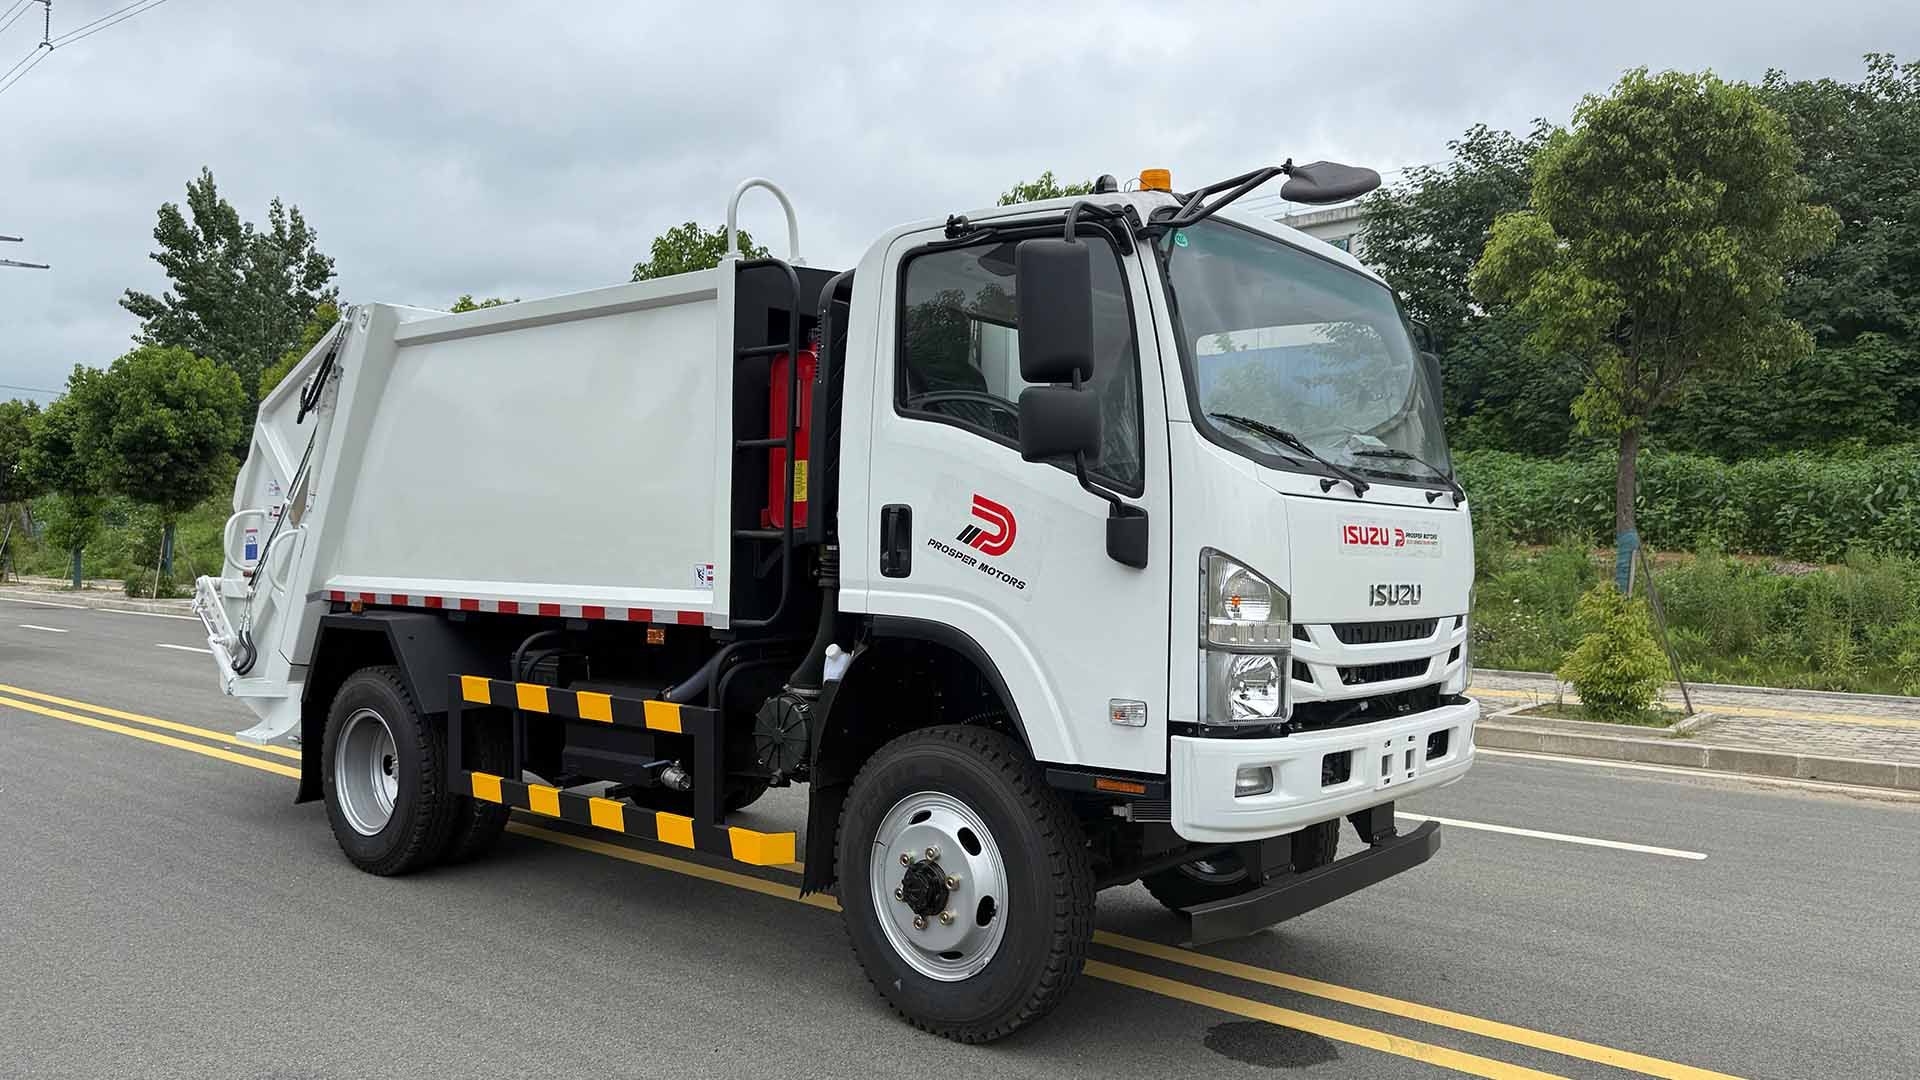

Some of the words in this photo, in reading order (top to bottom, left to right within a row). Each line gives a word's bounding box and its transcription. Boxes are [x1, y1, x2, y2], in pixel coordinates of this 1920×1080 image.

[1343, 525, 1389, 546] ISUZU
[927, 538, 977, 568] PROSPER
[978, 562, 1026, 590] MOTORS
[1369, 584, 1421, 606] ISUZU
